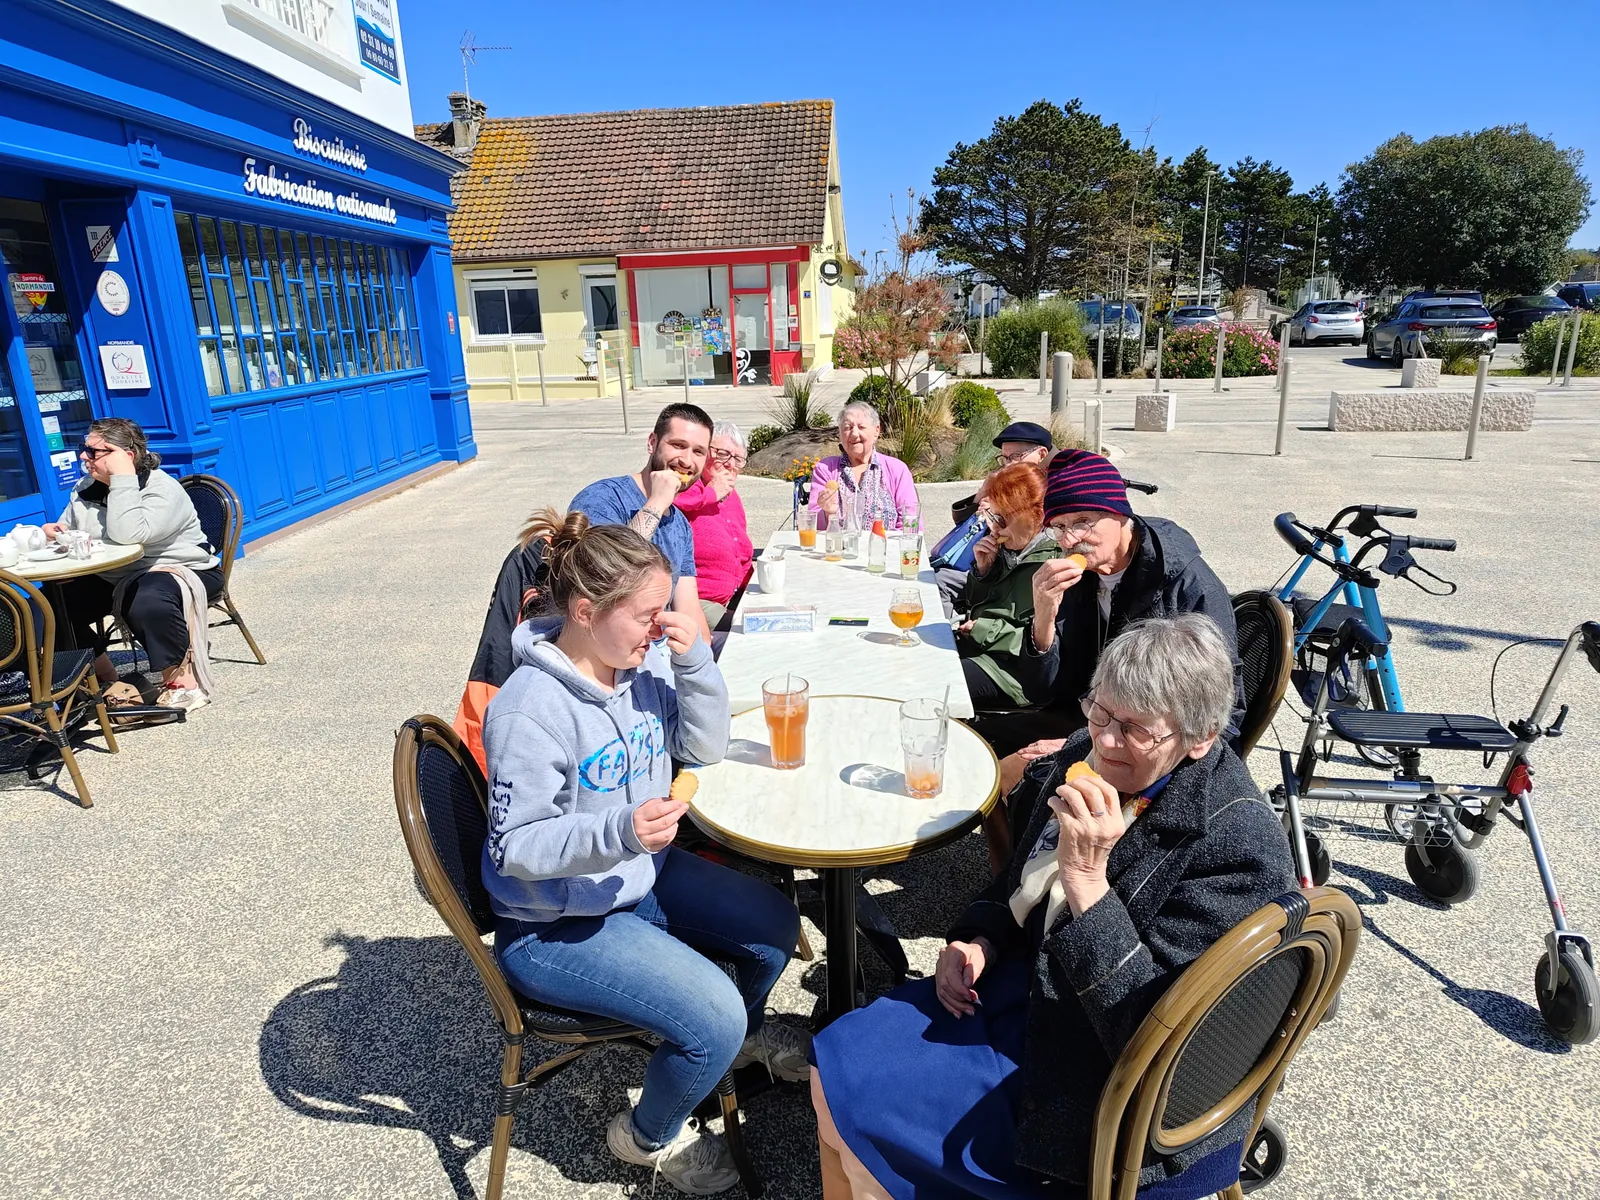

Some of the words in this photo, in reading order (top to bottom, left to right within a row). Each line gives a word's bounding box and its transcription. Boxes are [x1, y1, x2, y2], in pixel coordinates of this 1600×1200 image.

[293, 117, 368, 171] Biscuiterie
[243, 157, 335, 210] Fabrication
[336, 192, 397, 224] artisanale
[91, 230, 112, 259] LICENCE
[16, 283, 54, 291] NORMANDIE
